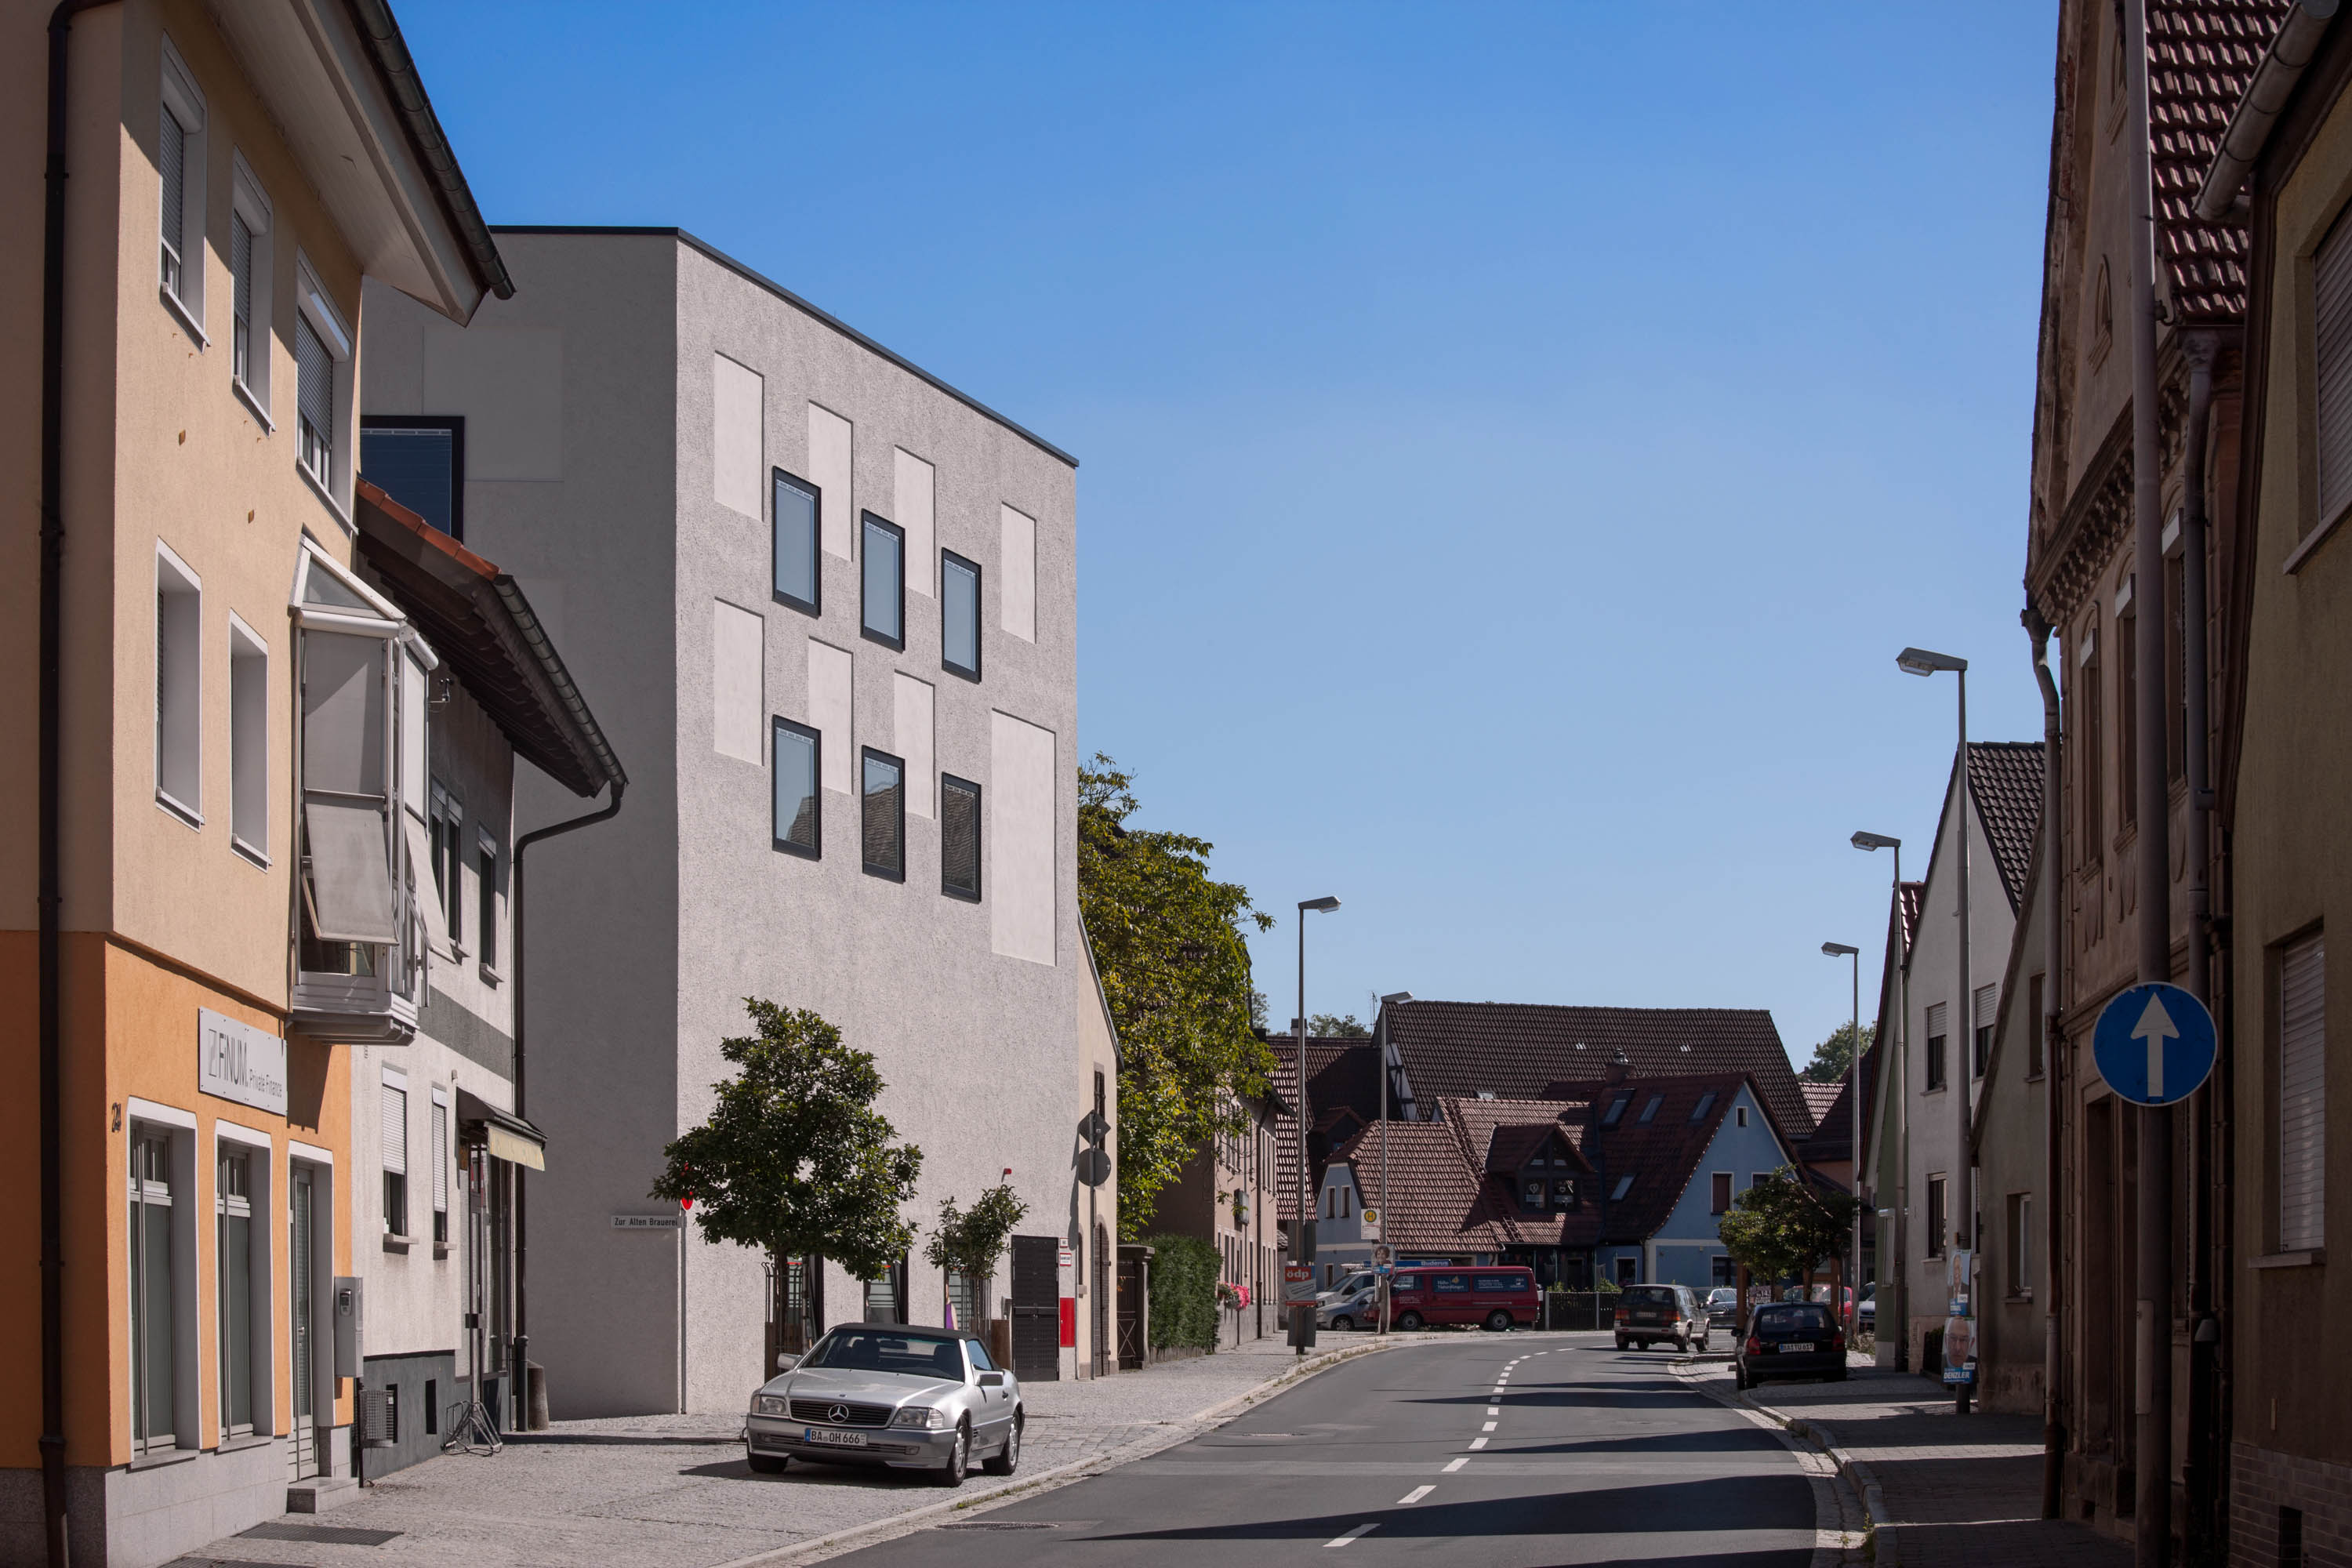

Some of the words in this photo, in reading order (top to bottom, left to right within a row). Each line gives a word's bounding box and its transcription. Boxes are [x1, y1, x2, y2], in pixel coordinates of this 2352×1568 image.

[615, 1218, 626, 1226] Zur
[630, 1218, 647, 1226] Alten
[650, 1218, 677, 1226] Brauerei
[1287, 1269, 1309, 1280] ödp
[811, 1430, 822, 1441] BA
[843, 1433, 860, 1444] 666
